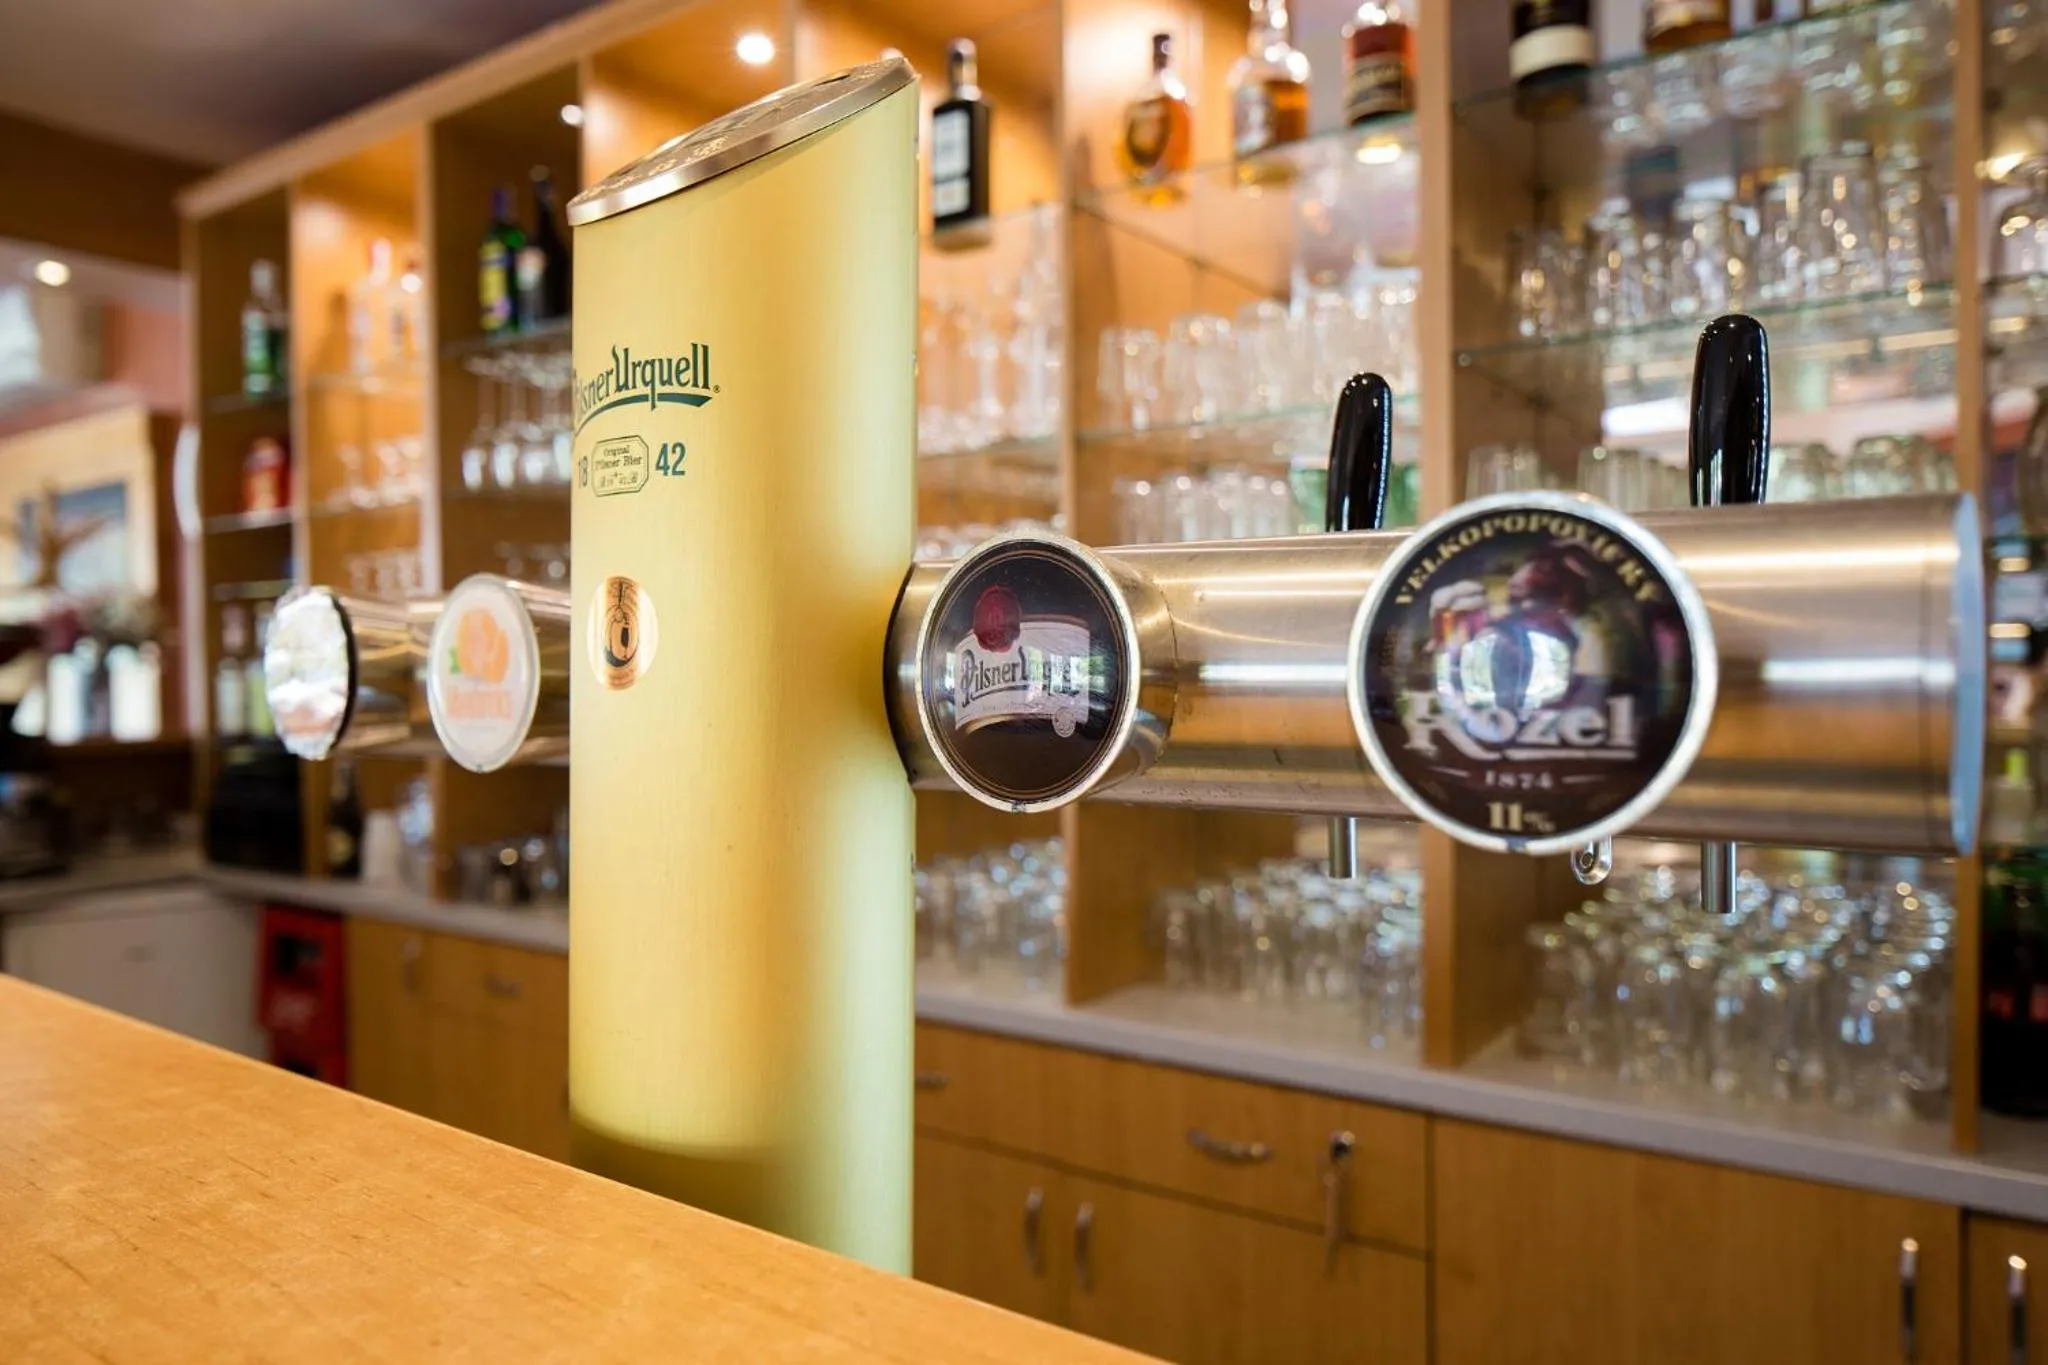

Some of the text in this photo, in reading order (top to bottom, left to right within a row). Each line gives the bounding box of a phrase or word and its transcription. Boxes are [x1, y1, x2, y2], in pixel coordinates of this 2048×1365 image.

[612, 343, 711, 411] Urquell
[655, 442, 686, 476] 42
[960, 649, 1019, 708] Pilsner
[1401, 689, 1637, 760] Kozel
